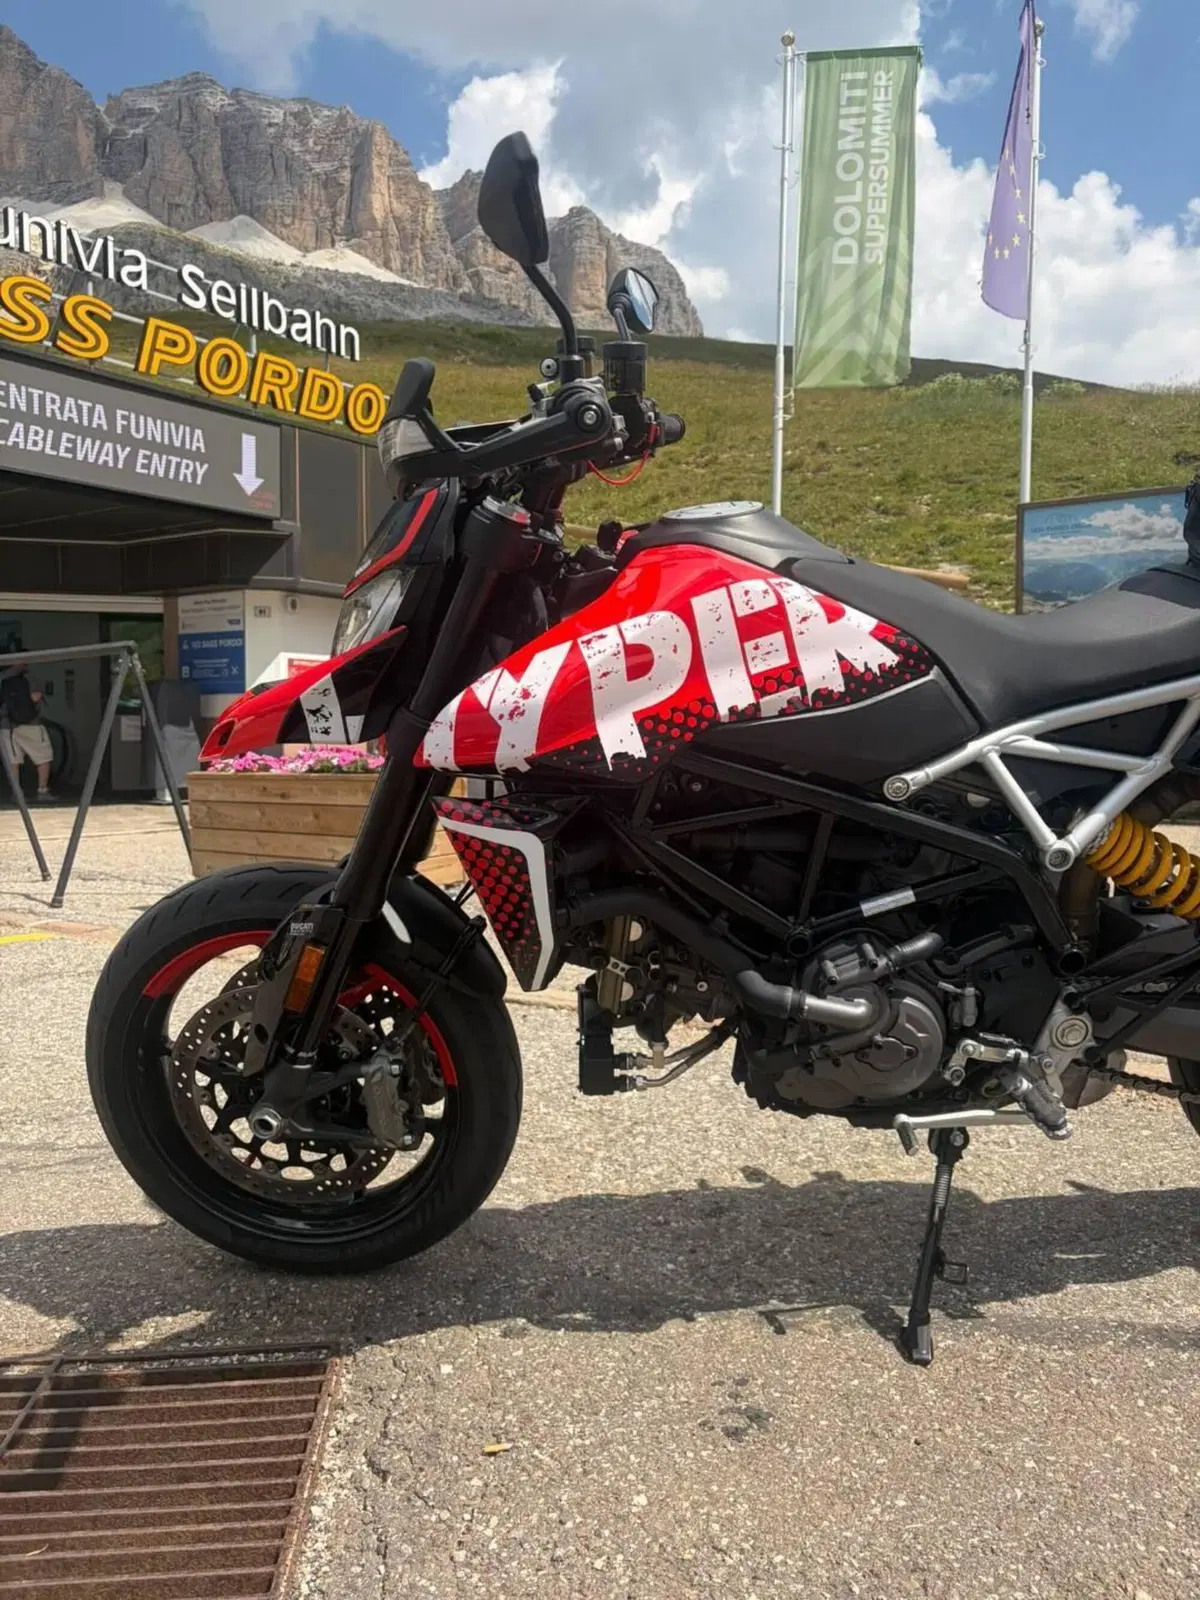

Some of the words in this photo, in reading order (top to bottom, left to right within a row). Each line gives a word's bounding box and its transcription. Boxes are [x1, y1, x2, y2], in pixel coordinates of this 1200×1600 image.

[832, 71, 868, 265] DOLOMITI
[864, 69, 894, 265] SUPERSUMMER
[181, 263, 361, 362] Seilbahn
[116, 408, 206, 454] FUNIVIA
[135, 448, 209, 486] ENTRY
